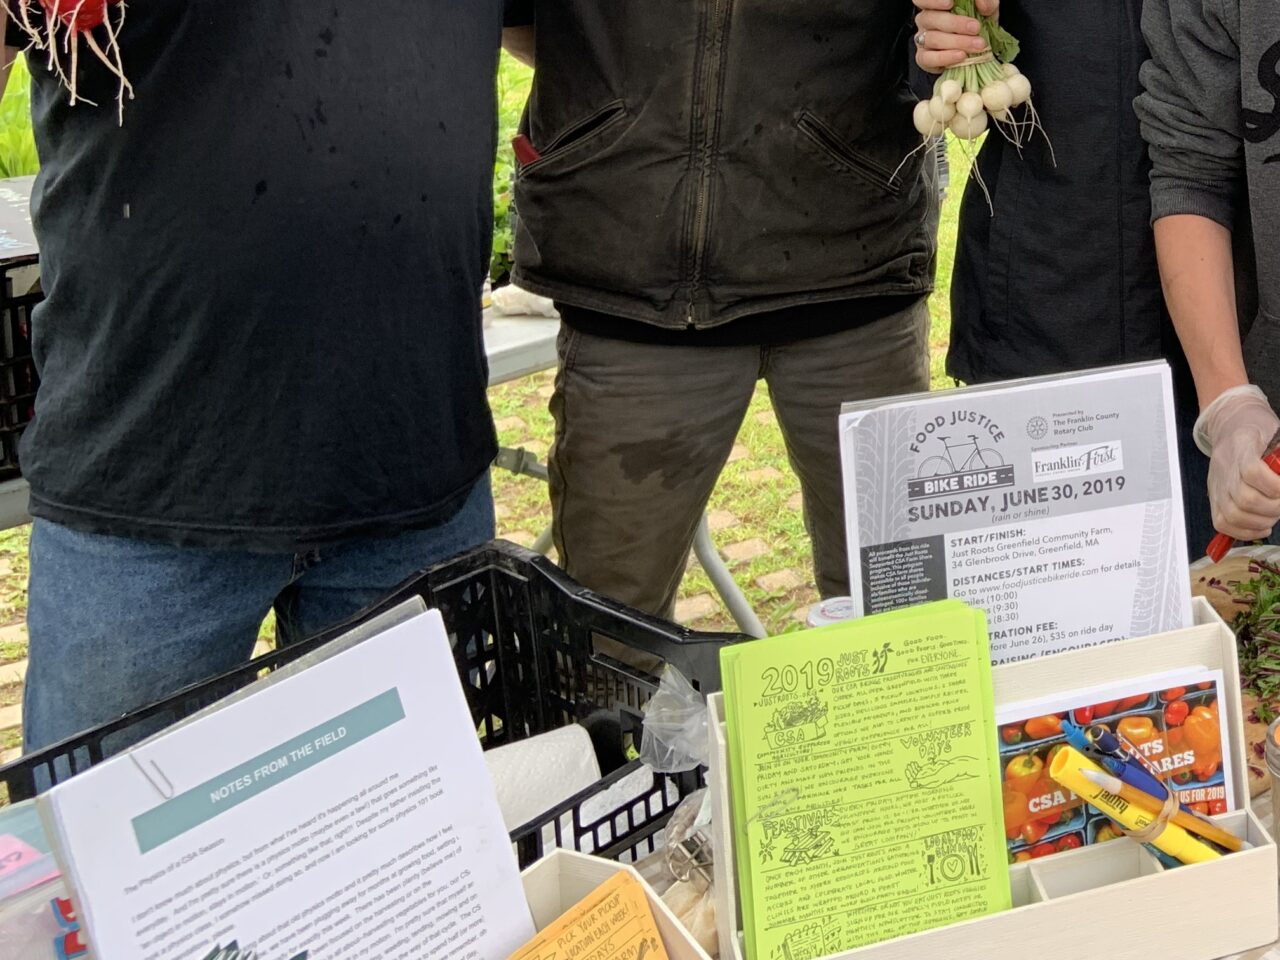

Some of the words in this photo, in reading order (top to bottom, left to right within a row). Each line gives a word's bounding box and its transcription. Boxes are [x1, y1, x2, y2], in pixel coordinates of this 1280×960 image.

[1053, 418, 1065, 426] The
[1066, 414, 1094, 424] Franklin
[1095, 411, 1119, 420] County
[1053, 426, 1076, 435] Rotary
[1077, 423, 1093, 432] Club
[910, 416, 945, 453] FOOD
[950, 410, 1005, 443] JUSTICE
[1034, 456, 1081, 474] Franklin
[1080, 445, 1117, 472] First
[924, 477, 959, 494] BIKE
[963, 471, 997, 488] RIDE
[907, 495, 994, 525] SUNDAY,
[999, 486, 1048, 510] JUNE
[1051, 482, 1077, 502] 30,
[1082, 475, 1125, 495] 2019
[991, 512, 1010, 522] (rain
[1012, 511, 1021, 519] or
[1023, 506, 1049, 517] shine)
[950, 528, 1025, 547] START/FINISH:
[951, 549, 968, 558] Just
[970, 544, 994, 555] Roots
[996, 536, 1040, 551] Greenfield
[1041, 530, 1088, 543] Community
[1090, 525, 1112, 535] Farm,
[951, 559, 962, 569] 34
[964, 552, 1010, 566] Glenbrook
[1011, 548, 1036, 559] Drive,
[1038, 540, 1083, 554] Greenfield,
[1085, 537, 1099, 546] MA
[952, 563, 1048, 586] DISTANCES/START
[1052, 557, 1084, 570] TIMES:
[952, 588, 966, 598] Go
[968, 587, 977, 595] to
[979, 567, 1099, 593] www.foodjusticebikeride.com
[1100, 564, 1112, 573] for
[1113, 559, 1141, 570] details
[986, 590, 1017, 603] (10:00)
[992, 600, 1018, 612] (9:30)
[993, 611, 1018, 623] (8:30)
[988, 625, 1032, 640] TRATION
[1036, 621, 1057, 632] FEE:
[990, 639, 1007, 650] fore
[1009, 634, 1029, 647] June
[1050, 630, 1065, 641] $35
[1080, 625, 1096, 635] ride
[1098, 624, 1113, 633] day
[761, 657, 835, 697] 2019
[837, 650, 869, 667] JUST
[836, 664, 870, 683] ROOTS
[775, 728, 805, 747] CSA
[900, 722, 972, 750] VOLUNTEER
[919, 743, 952, 759] DAYS
[1129, 739, 1164, 759] TS
[210, 773, 253, 805] NOTES
[254, 755, 290, 786] FROM
[290, 742, 314, 767] THE
[313, 725, 349, 756] FIELD
[427, 763, 437, 773] lik
[1028, 794, 1067, 814] CSA
[1180, 790, 1191, 802] US
[1192, 789, 1207, 800] FOR
[1208, 787, 1225, 799] 2019
[124, 881, 139, 895] The
[137, 867, 167, 888] Physics
[165, 862, 175, 873] of
[174, 860, 182, 868] a
[179, 849, 198, 865] CSA
[198, 836, 225, 855] Season
[557, 931, 577, 949] PICK
[577, 913, 598, 933] YOUR
[596, 893, 621, 917] PICKUP
[565, 933, 595, 959] LOCATION
[593, 921, 611, 940] EACH
[609, 901, 630, 927] WEEK!
